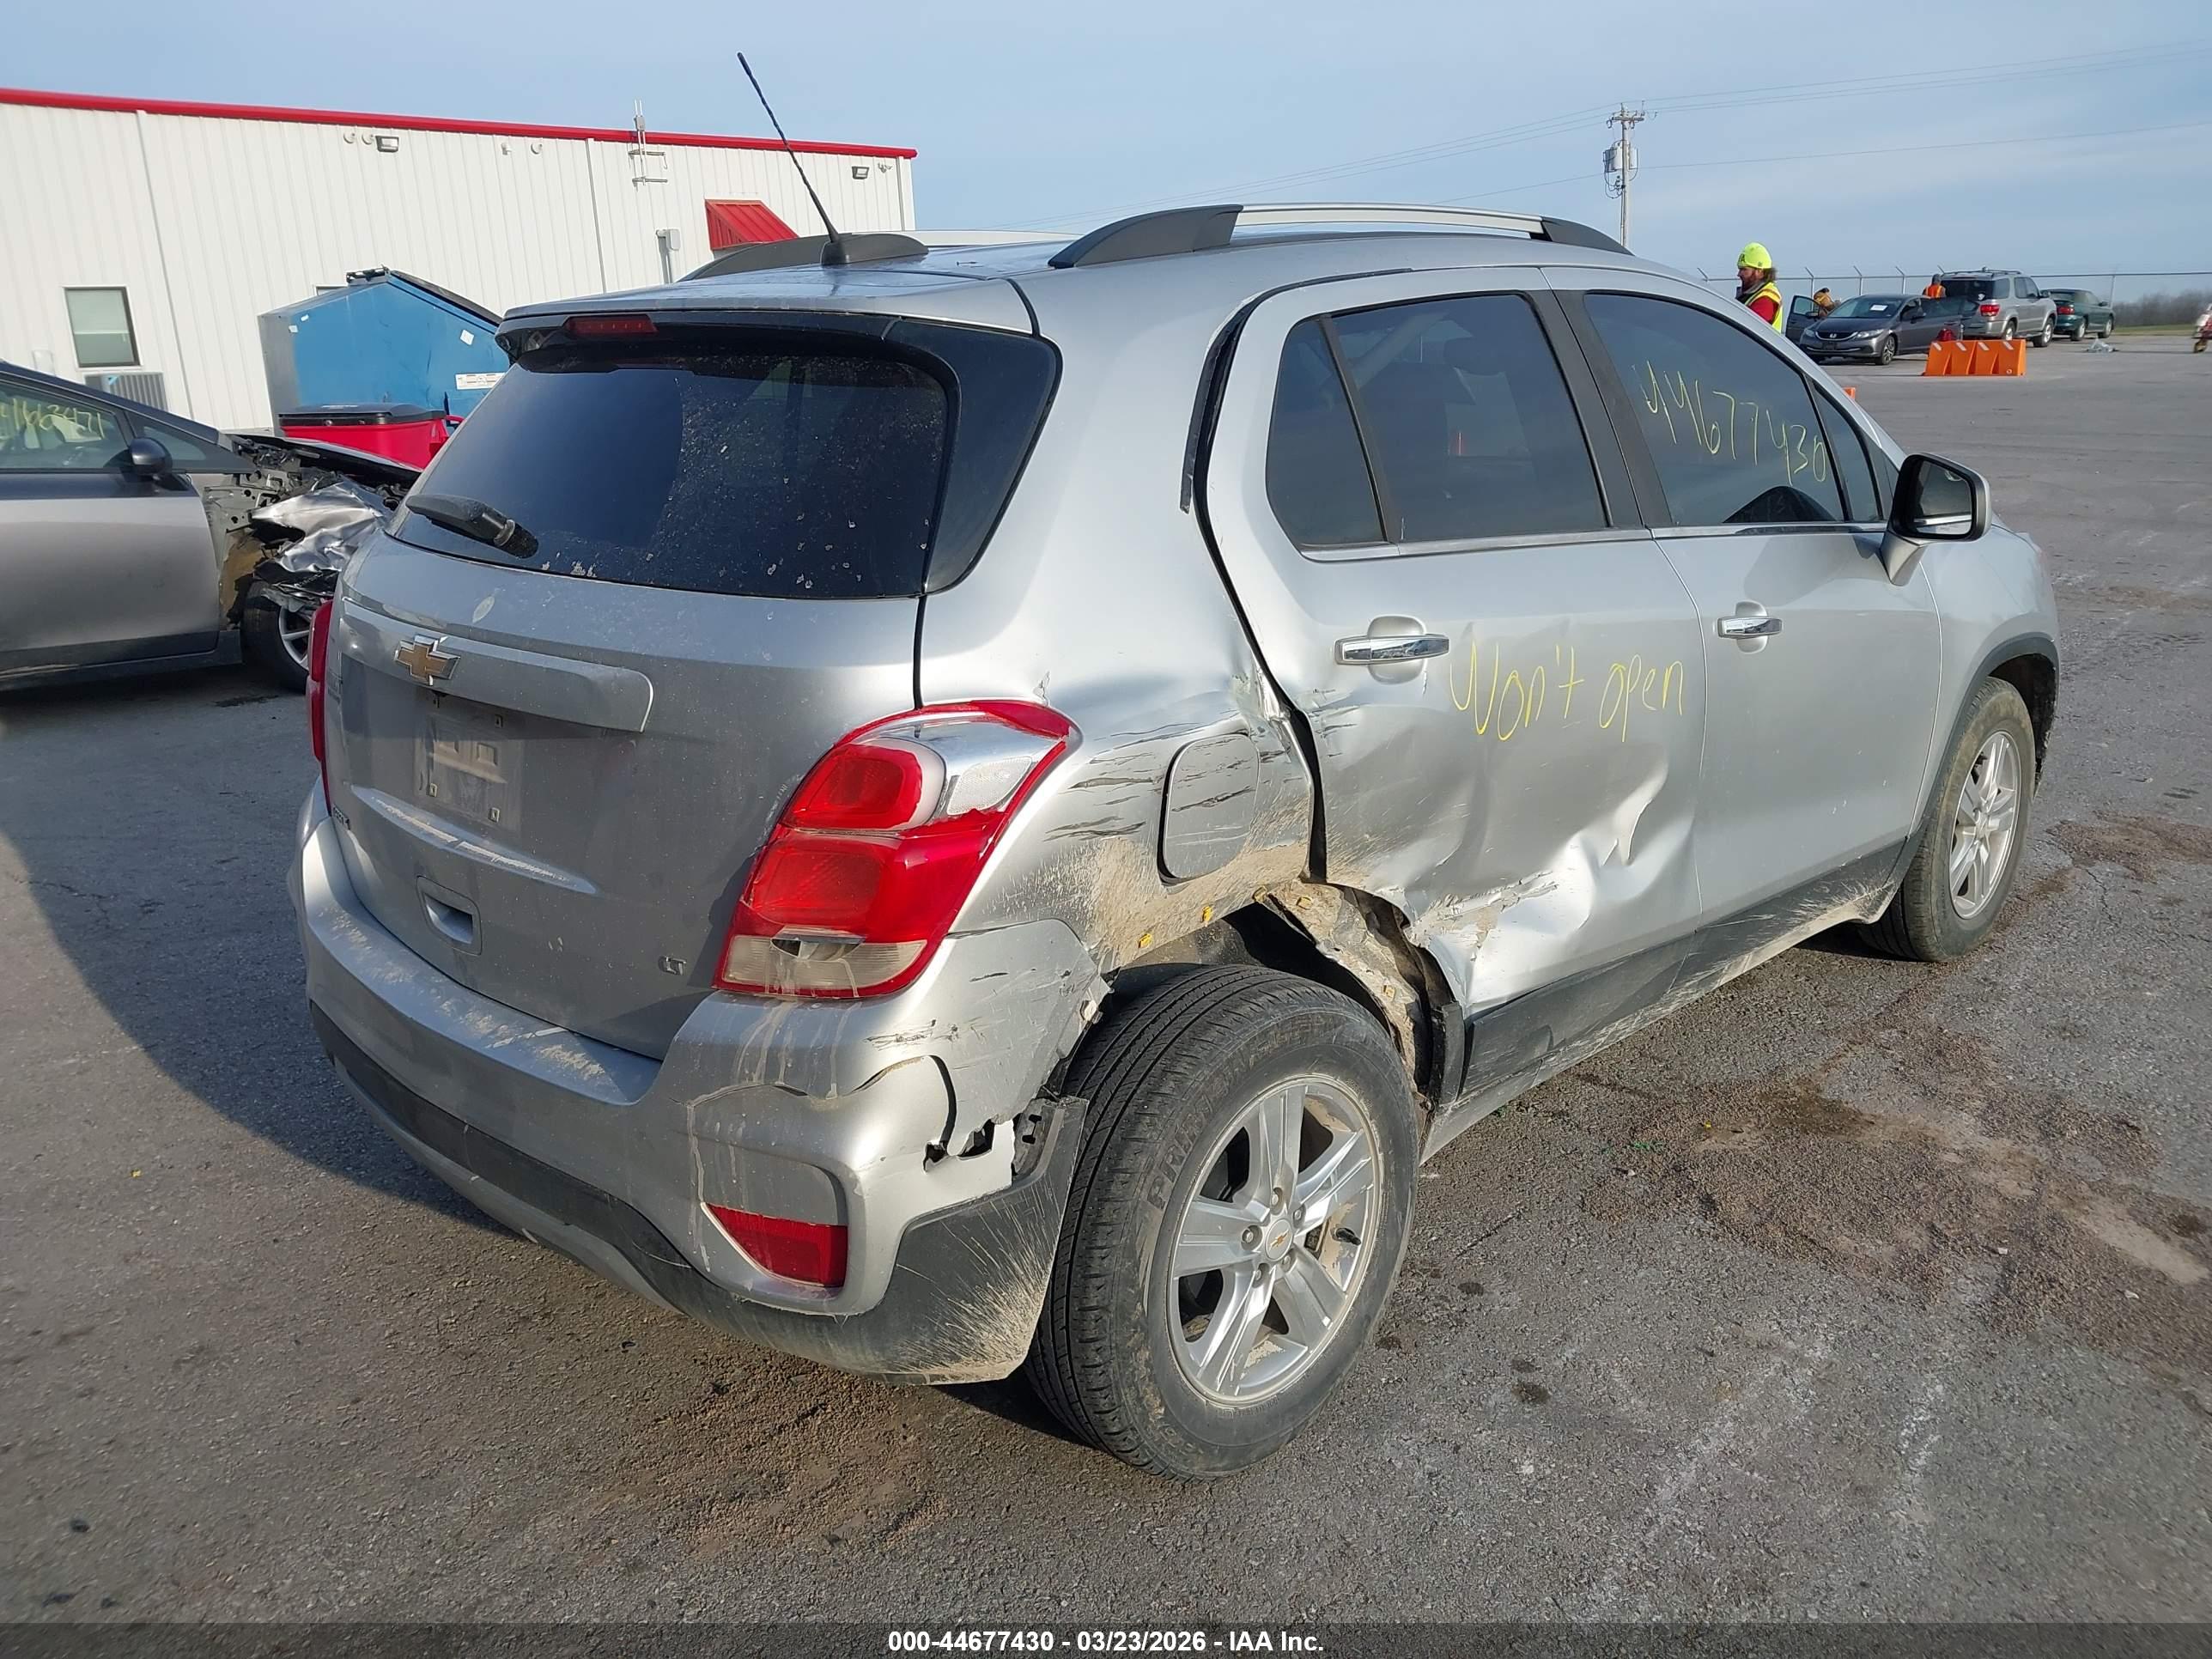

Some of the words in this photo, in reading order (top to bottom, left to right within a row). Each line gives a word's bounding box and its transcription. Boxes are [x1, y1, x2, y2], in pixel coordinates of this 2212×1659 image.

[1635, 360, 1827, 487] 44677430
[1449, 640, 1584, 741] Won't
[1599, 653, 1684, 743] open
[659, 956, 688, 976] LT
